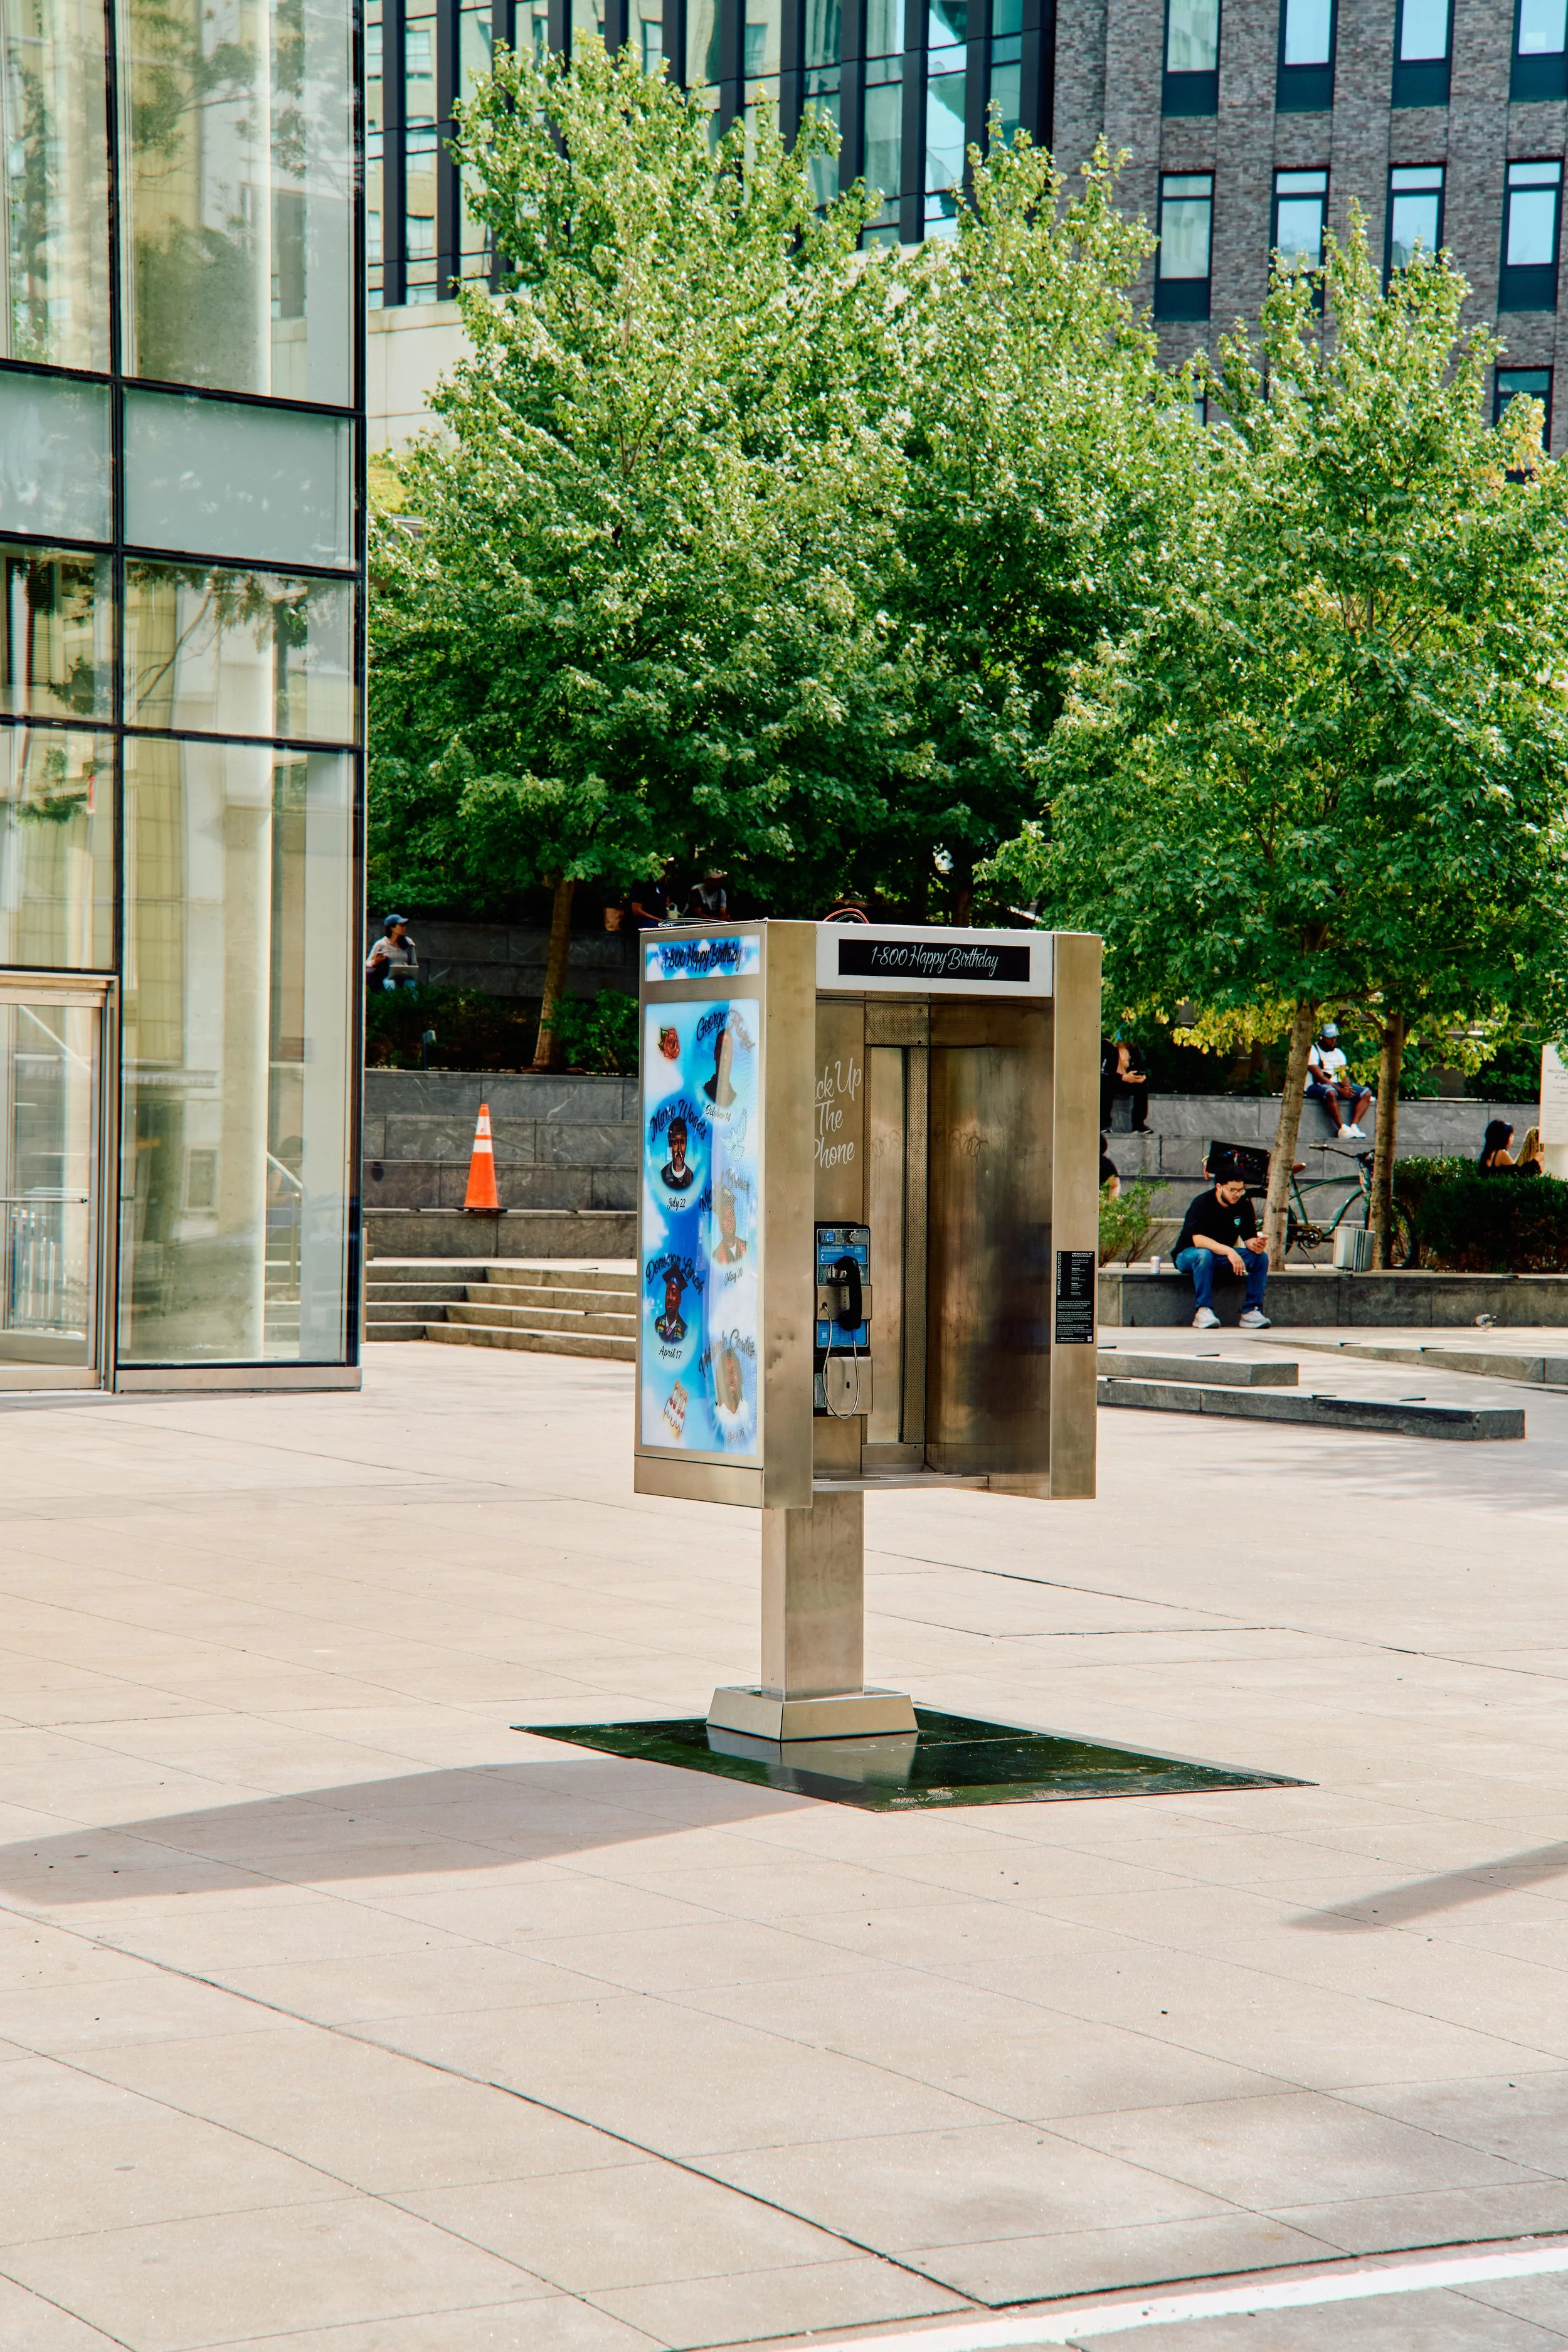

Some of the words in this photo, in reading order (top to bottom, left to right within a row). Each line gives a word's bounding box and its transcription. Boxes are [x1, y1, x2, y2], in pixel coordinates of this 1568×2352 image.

[664, 948, 686, 968] 1-800
[686, 943, 710, 973] Happy
[871, 946, 908, 965] 1-800
[908, 944, 948, 974] Happy
[947, 947, 999, 977] Birthday
[696, 1012, 726, 1041] George
[815, 1066, 835, 1099] ck
[835, 1057, 862, 1101] Up
[650, 1104, 675, 1142] Mario
[678, 1099, 707, 1140] Woods
[705, 1104, 726, 1120] October
[725, 1112, 731, 1122] 14
[815, 1099, 844, 1136] The
[667, 1197, 679, 1211] July
[679, 1199, 686, 1208] 22
[645, 1254, 681, 1284] Donovan
[681, 1256, 705, 1296] Lynch
[724, 1271, 737, 1286] May
[736, 1267, 743, 1278] 20
[659, 1345, 675, 1360] April
[675, 1350, 682, 1360] 17
[728, 1429, 738, 1444] July
[738, 1428, 744, 1438] 16
